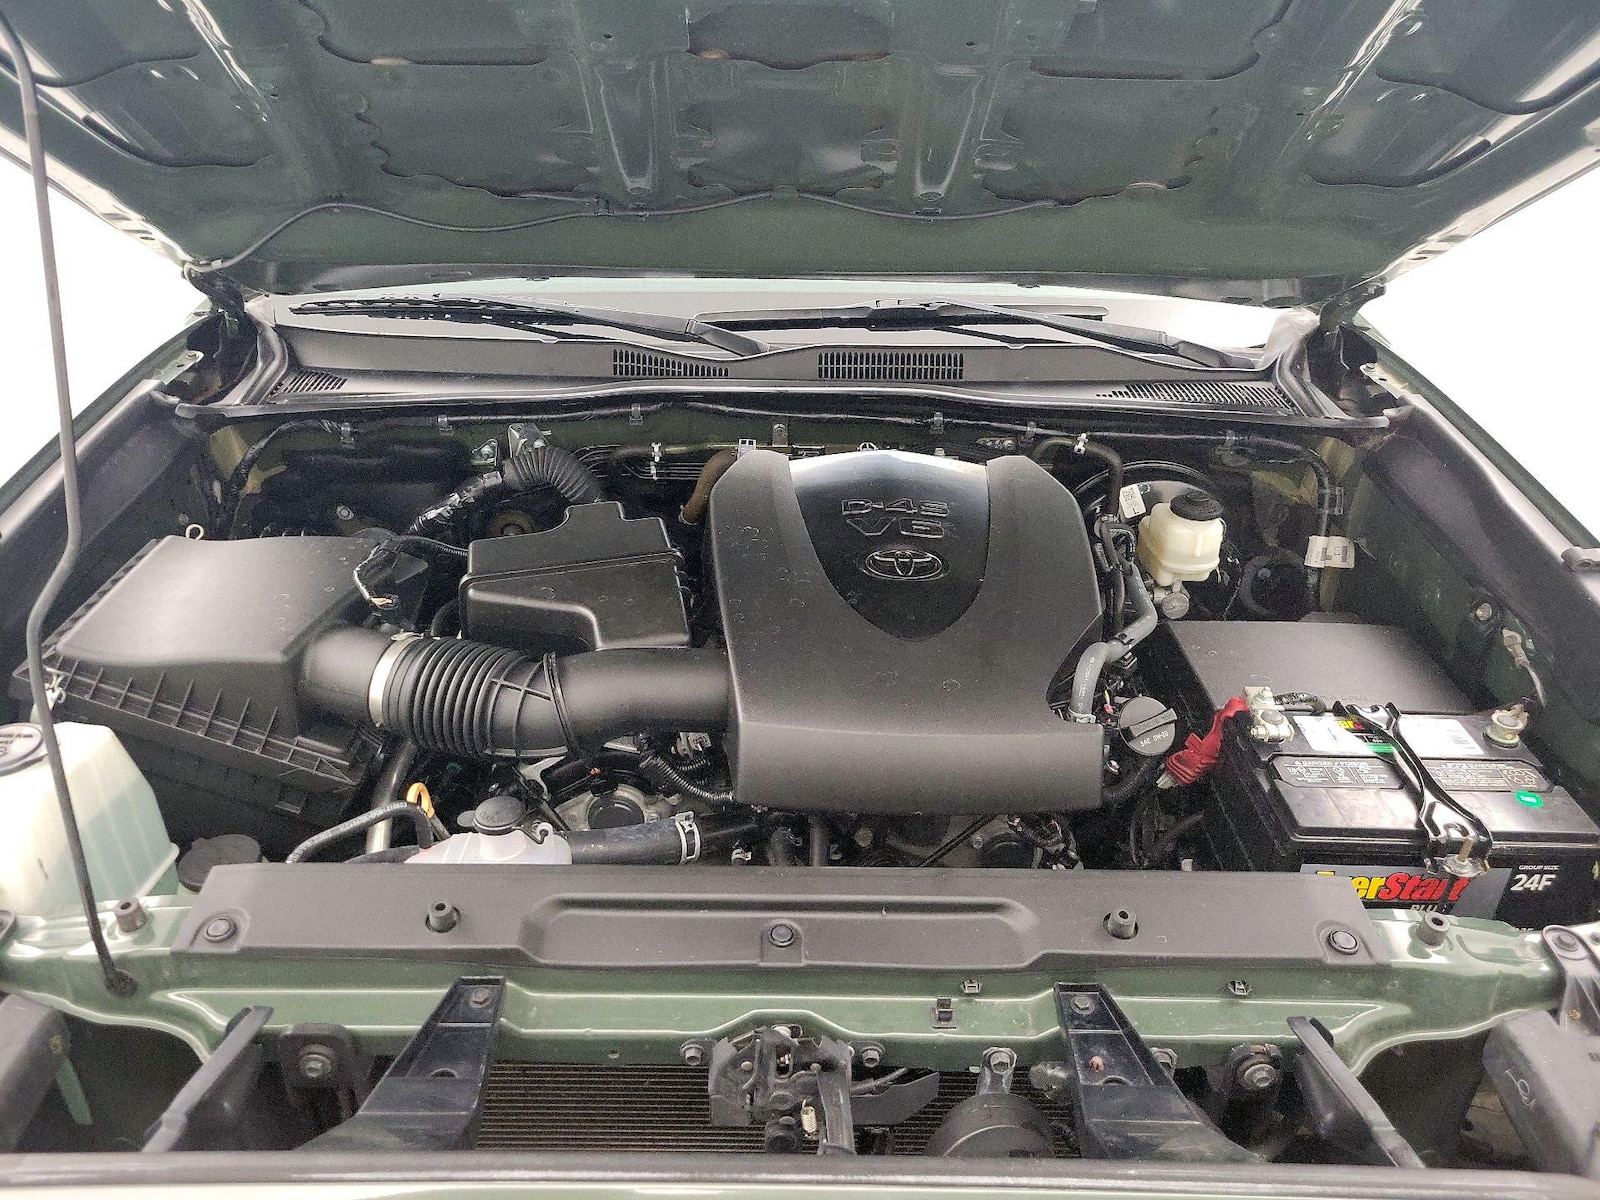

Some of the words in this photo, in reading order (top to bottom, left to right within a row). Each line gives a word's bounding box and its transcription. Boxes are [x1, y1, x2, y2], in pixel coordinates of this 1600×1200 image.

[841, 498, 950, 517] D-4S
[846, 516, 945, 539] V6
[1140, 738, 1151, 747] SAE
[1510, 873, 1556, 891] 24F
